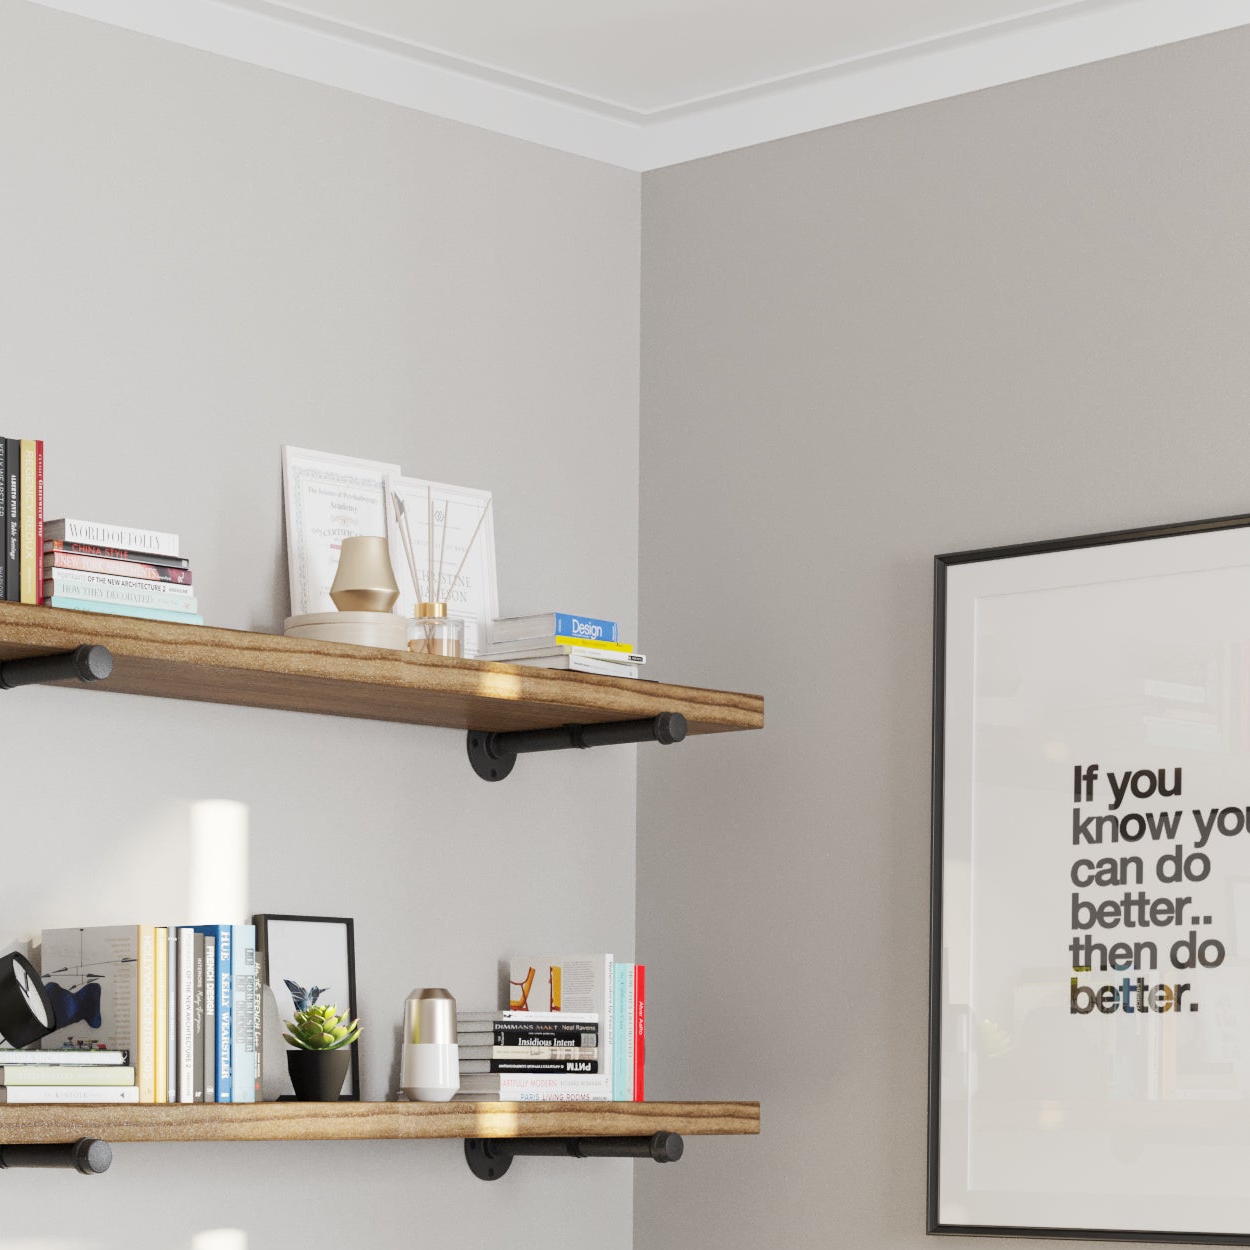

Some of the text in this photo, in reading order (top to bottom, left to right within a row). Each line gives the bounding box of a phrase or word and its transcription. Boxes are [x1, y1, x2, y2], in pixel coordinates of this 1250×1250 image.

[60, 555, 78, 567] NEW
[72, 544, 128, 559] CHINA STYLE
[62, 584, 80, 594] HOW
[84, 586, 103, 597] THEY
[106, 589, 153, 603] DECORATED
[107, 578, 120, 586] NEW
[121, 580, 161, 591] ARCHITECTURE
[572, 619, 603, 639] Design
[1074, 764, 1182, 810] If you
[1072, 806, 1250, 848] know yo
[1071, 845, 1211, 887] can do
[1071, 892, 1212, 930] better..
[1069, 931, 1226, 972] then do
[185, 970, 192, 980] OF
[206, 946, 214, 1015] FRENCH DESIGN
[142, 936, 151, 1080] HOLLYWOOD INTERIORS
[221, 931, 230, 1079] HUE KELLY WEARSTLER
[245, 948, 254, 1052] LE CORBUSIER
[1070, 977, 1199, 1014] better.
[518, 1037, 575, 1047] Insidious Intent
[567, 1063, 591, 1071] РИТМ
[520, 1093, 590, 1101] PARIS LIVING ROOMS
